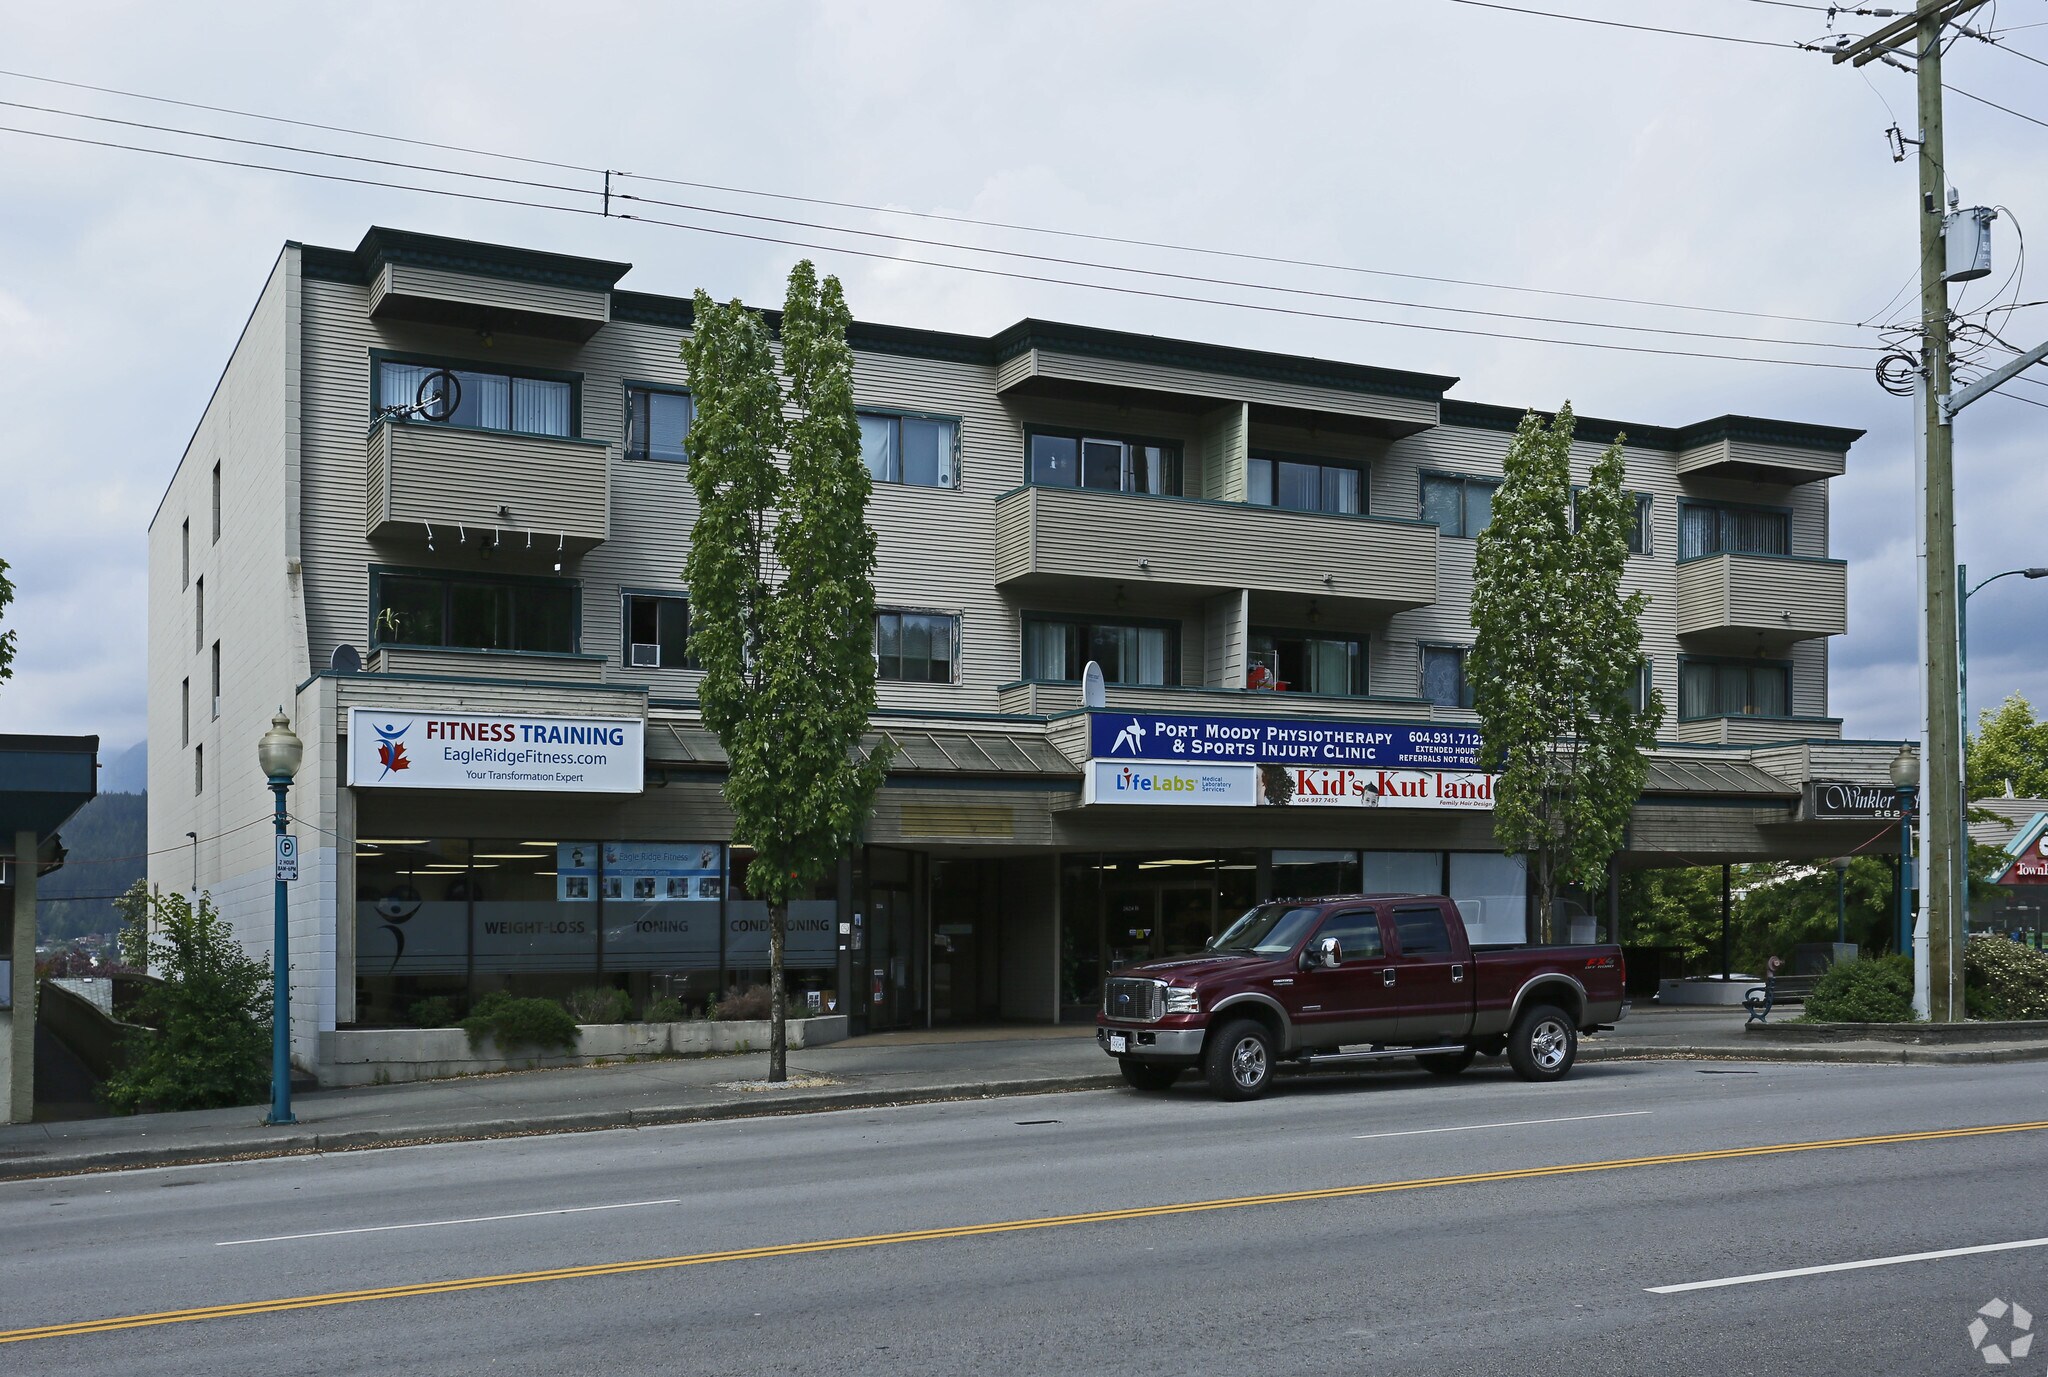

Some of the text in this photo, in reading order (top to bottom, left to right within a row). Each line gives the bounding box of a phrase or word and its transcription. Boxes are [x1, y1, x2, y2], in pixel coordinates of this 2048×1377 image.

[426, 720, 624, 746] FITNESS TRAINING
[1155, 722, 1393, 745] PORT MOODY PHYSIOTHERAPY
[443, 746, 607, 766] EagleRidgeFitness.com
[1172, 738, 1376, 760] & SPORTS INJURY CLINIC
[1415, 745, 1453, 754] EXTENDED
[1399, 754, 1441, 763] REFERRALS
[1443, 755, 1458, 763] NOT
[466, 769, 584, 784] Your Transformation Expert
[1116, 767, 1195, 792] LifeLabs
[1202, 781, 1232, 789] Laboratory
[1295, 769, 1492, 800] Kid's Kut land
[1825, 785, 1895, 810] Winkler
[1874, 810, 1901, 818] 262
[284, 843, 290, 852] P
[619, 852, 688, 863] Eagle Ridge Fitness
[485, 919, 830, 935] WEIGHT-LOSS TONING CONDONING
[1586, 957, 1615, 965] FX4
